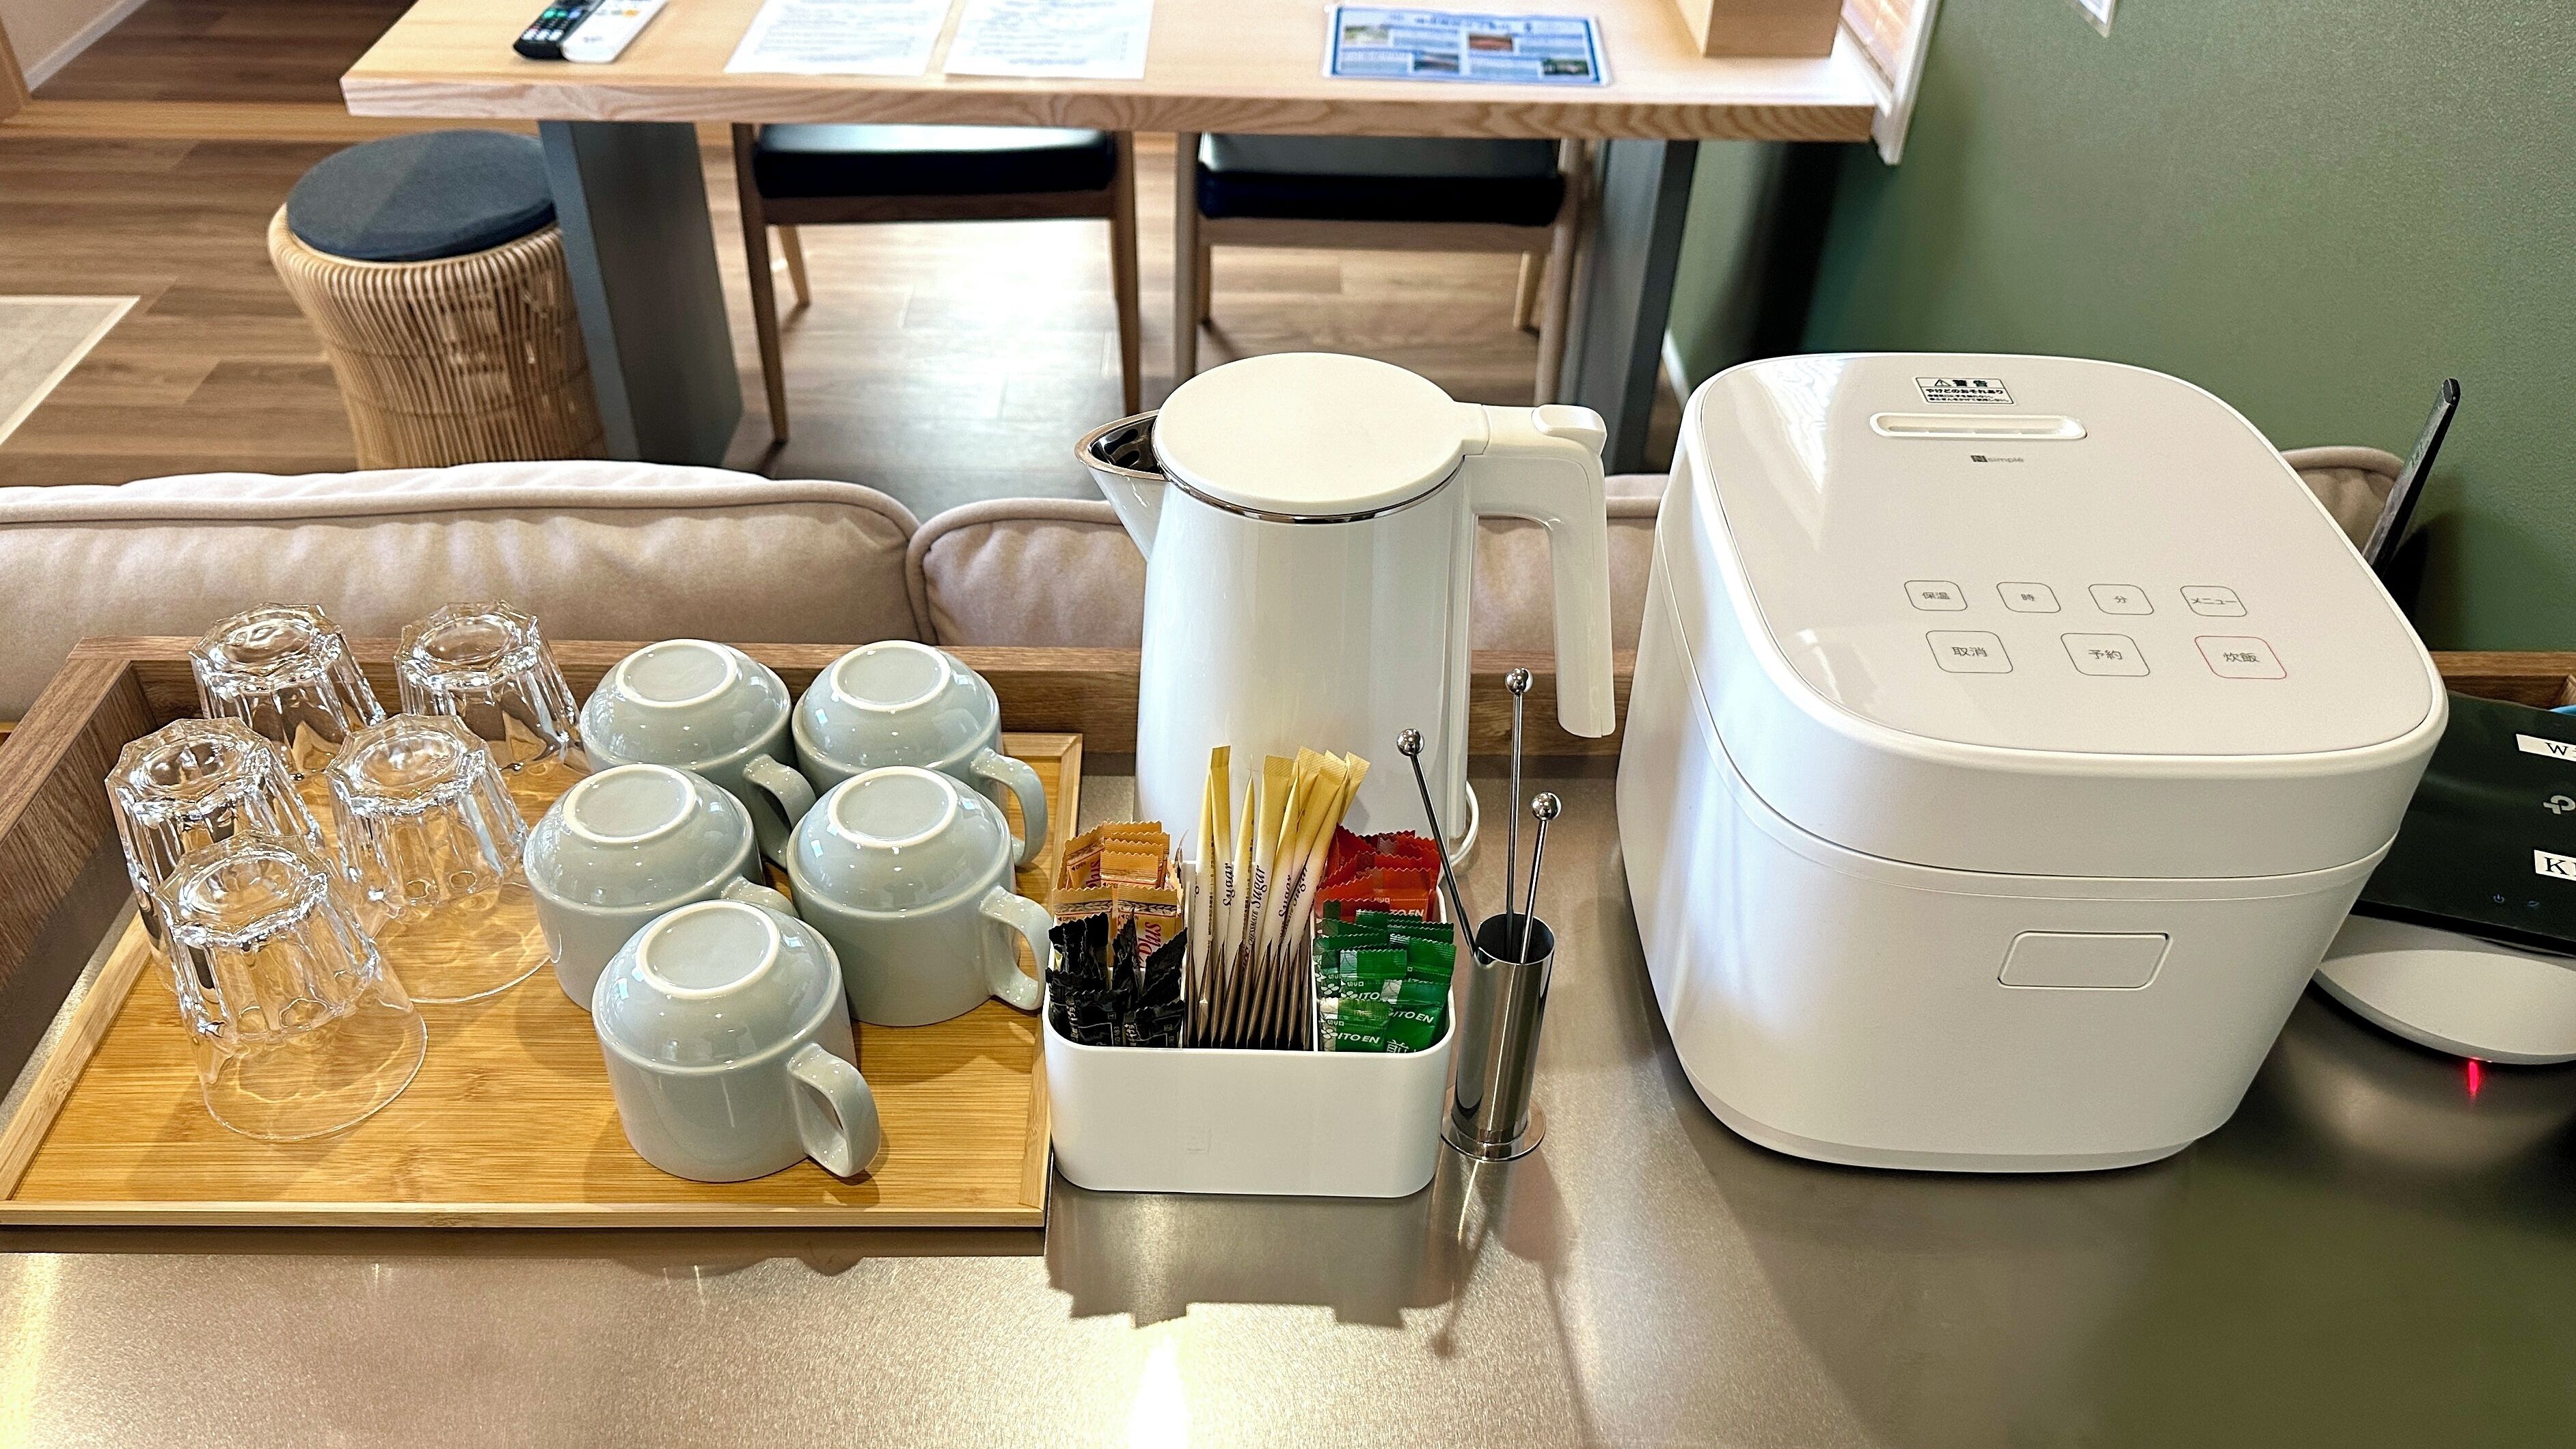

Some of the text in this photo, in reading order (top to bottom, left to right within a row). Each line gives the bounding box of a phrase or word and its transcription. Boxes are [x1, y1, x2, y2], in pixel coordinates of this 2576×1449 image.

[1922, 592, 1950, 600] 保温
[2020, 593, 2035, 601] 時
[1951, 647, 1988, 658] 取消
[2088, 649, 2123, 660] 予約
[2223, 652, 2260, 663] 炊飯
[2545, 742, 2576, 759] W
[2544, 856, 2576, 879] K
[1251, 864, 1268, 908] Sugar
[1415, 1014, 1435, 1024] EN
[1338, 1032, 1381, 1044] ITO EN
